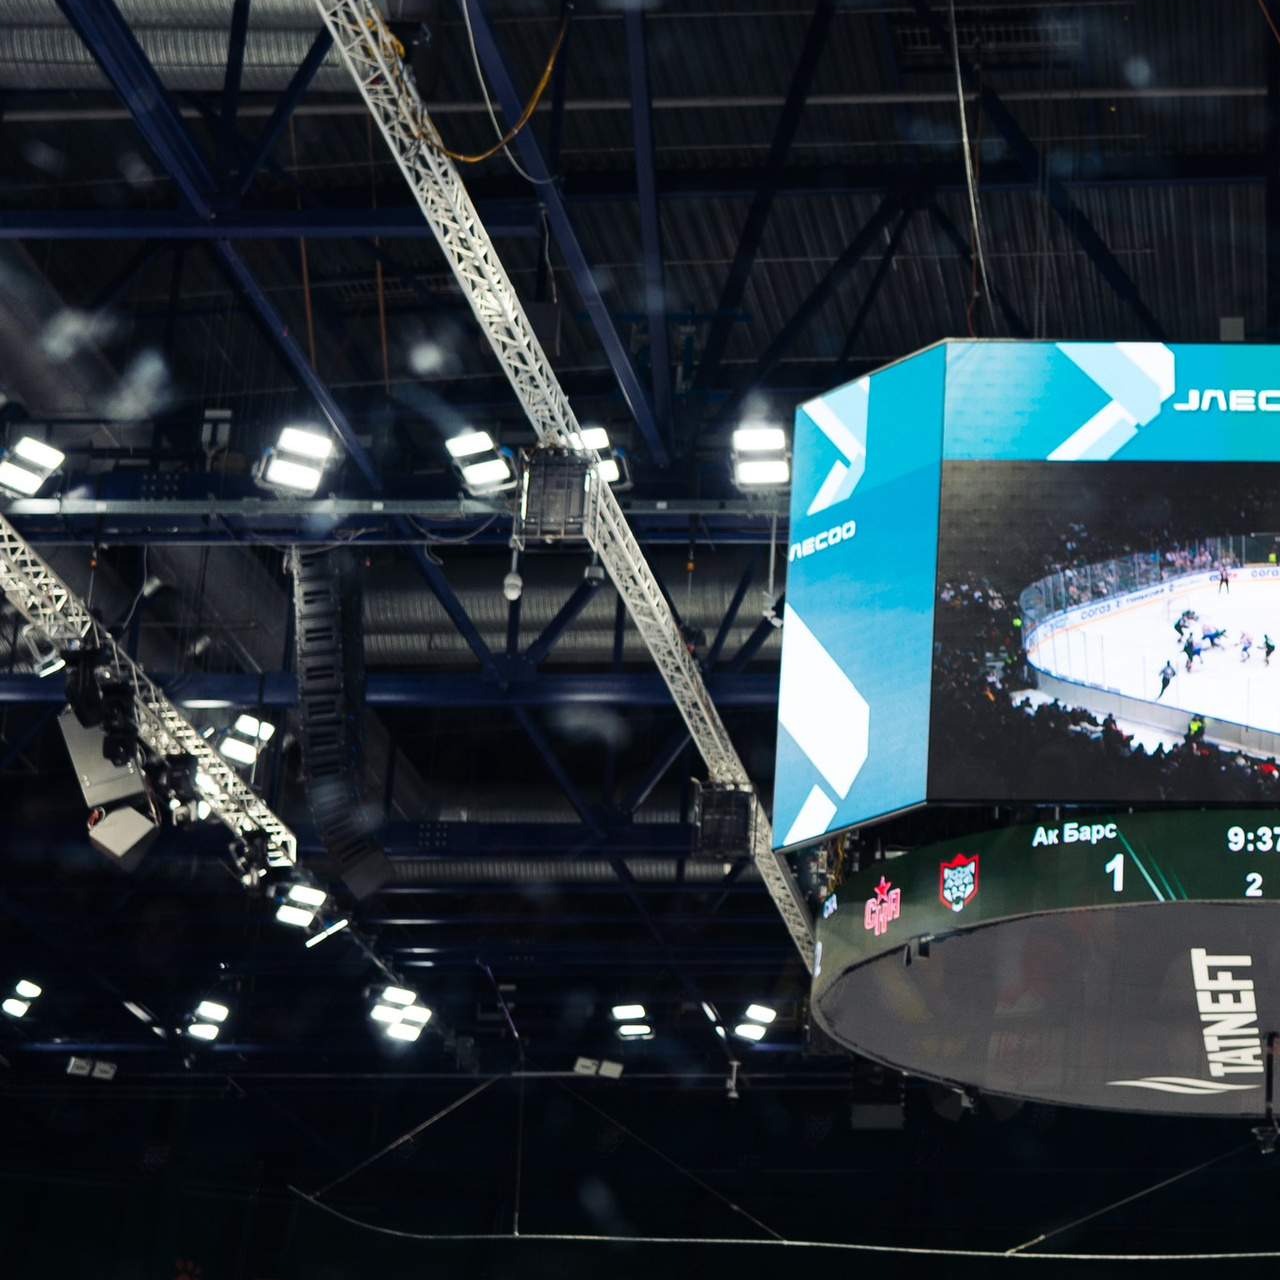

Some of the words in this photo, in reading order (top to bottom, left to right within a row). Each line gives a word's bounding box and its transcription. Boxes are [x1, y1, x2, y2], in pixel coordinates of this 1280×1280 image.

[1031, 826, 1059, 847] Ак
[1062, 822, 1118, 845] Барс
[1104, 852, 1125, 893] 1
[1246, 872, 1263, 898] 2
[1190, 947, 1265, 1077] TATNEFT
